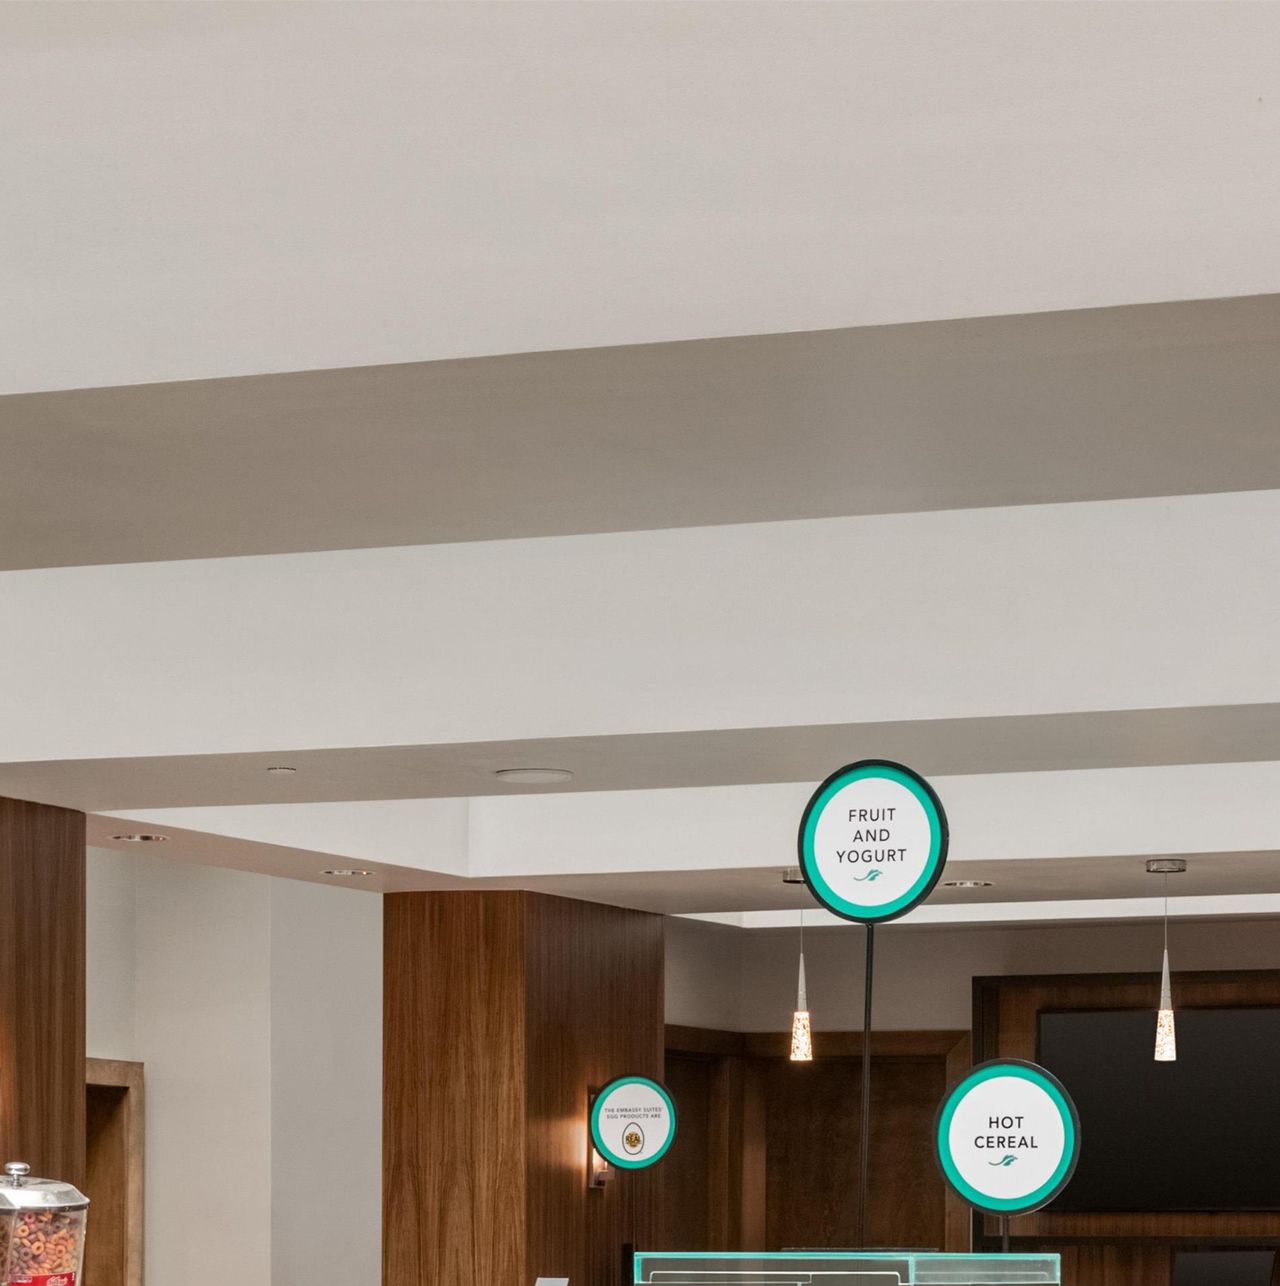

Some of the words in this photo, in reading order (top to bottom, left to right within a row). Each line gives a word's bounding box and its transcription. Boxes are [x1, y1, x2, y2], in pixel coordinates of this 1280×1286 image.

[848, 808, 896, 822] FRUIT
[852, 828, 890, 842] AND
[836, 848, 907, 864] YOGURT
[988, 1116, 1024, 1129] HOT
[974, 1135, 1039, 1149] CEREAL
